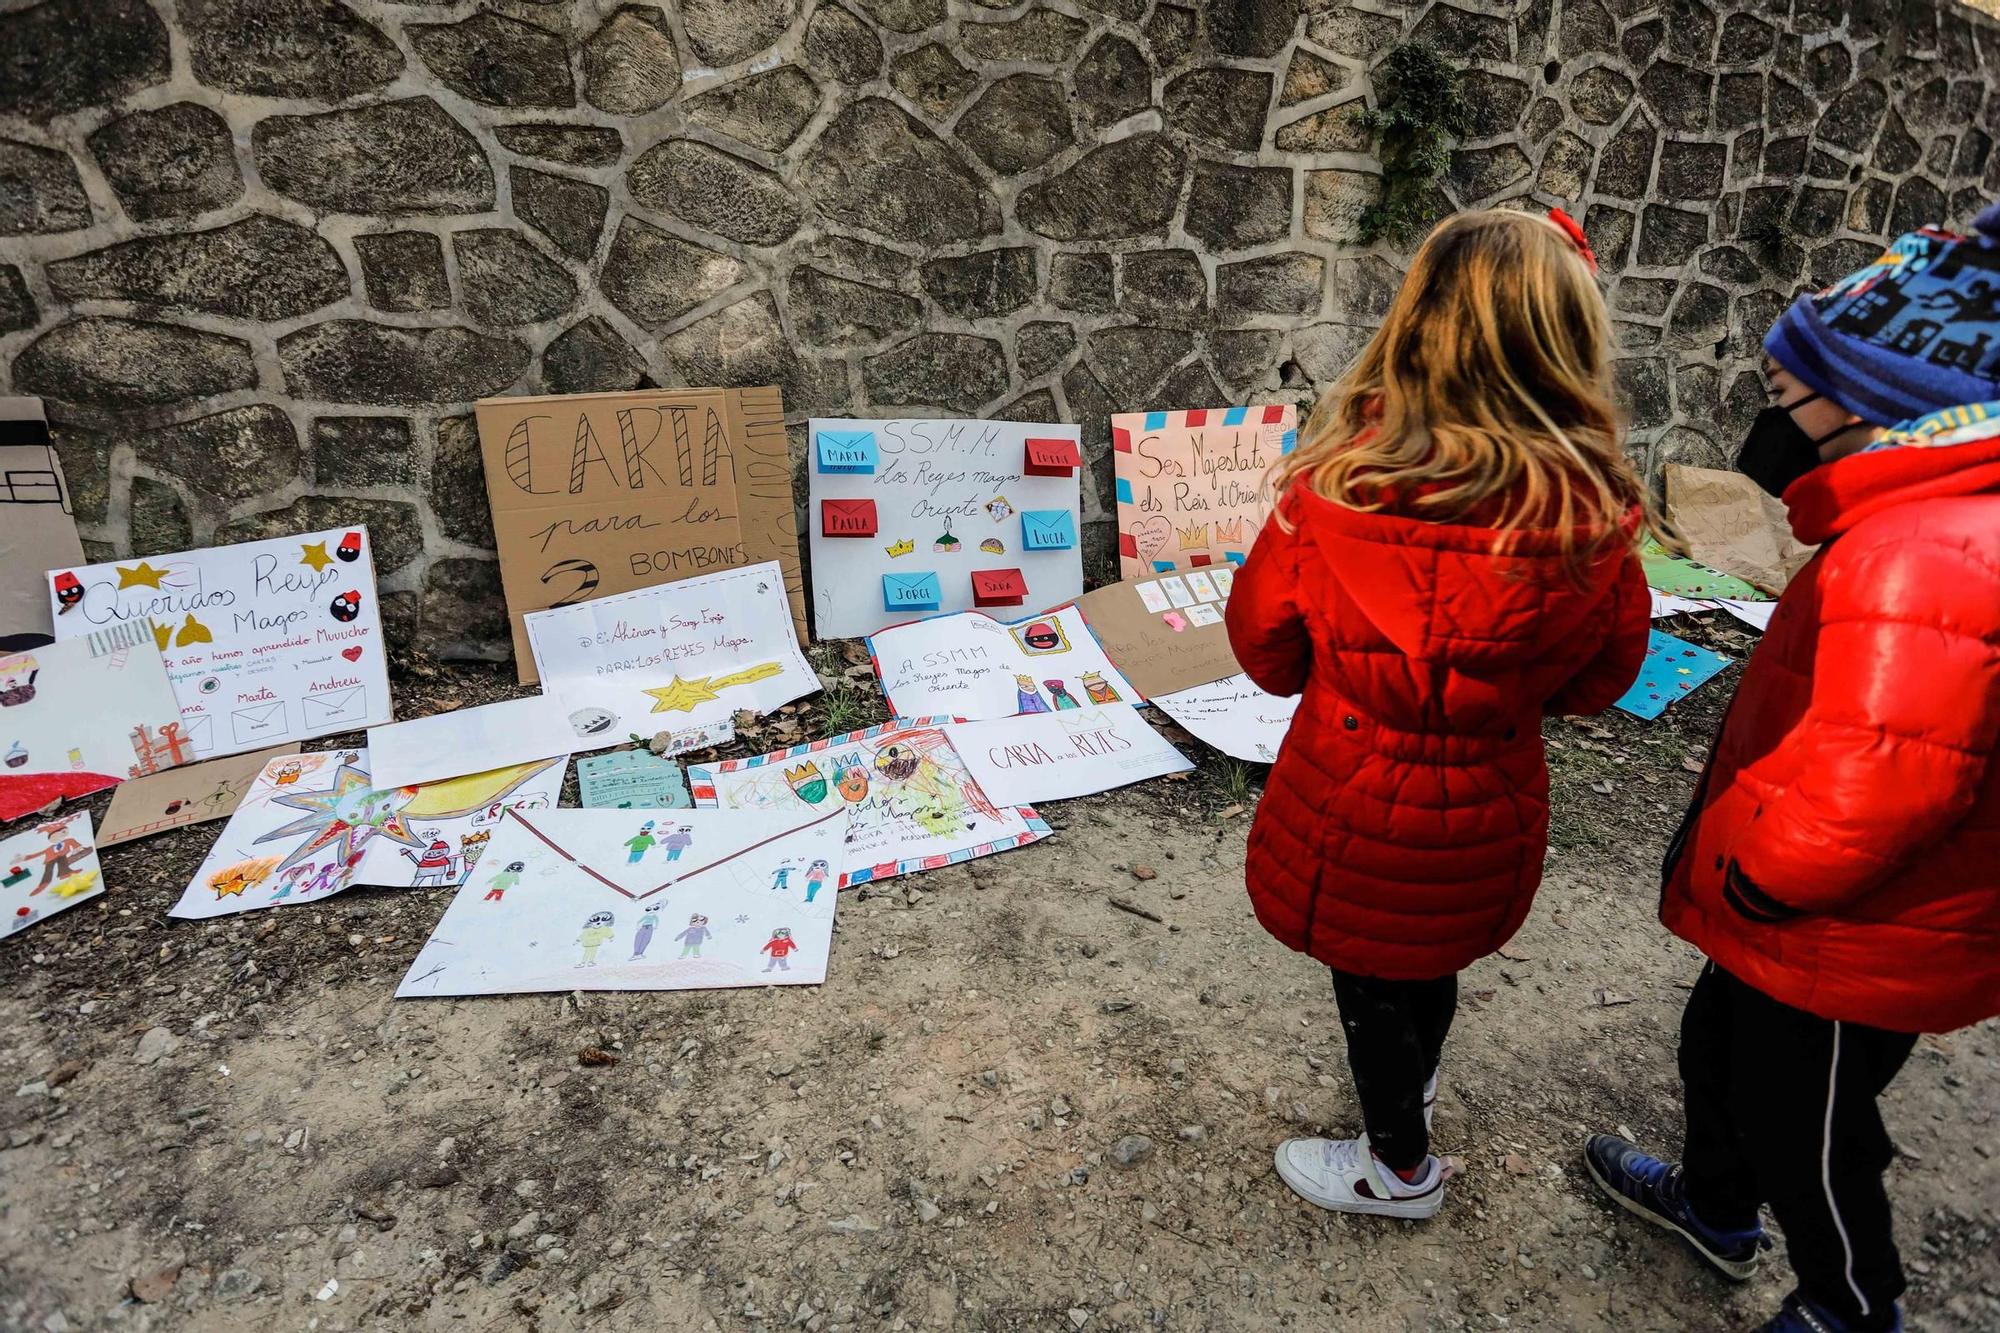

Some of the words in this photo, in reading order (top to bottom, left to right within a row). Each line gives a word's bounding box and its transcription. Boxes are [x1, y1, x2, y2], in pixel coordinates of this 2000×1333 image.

[505, 405, 736, 494] CARTA
[827, 449, 868, 462] MARTA
[1138, 436, 1187, 478] Ses
[1190, 431, 1266, 490] Majestats
[913, 460, 966, 496] Reyes
[911, 493, 978, 518] Oriente
[1139, 485, 1163, 513] els
[529, 514, 661, 553] para
[672, 497, 737, 523] los
[832, 514, 868, 530] PAULA
[1033, 528, 1066, 545] LUCIA
[83, 567, 236, 625] Queridos
[250, 553, 339, 602] Reyes
[252, 635, 312, 656] aprendido
[237, 686, 278, 704] Marta
[308, 674, 362, 693] Andreu
[989, 742, 1055, 769] CARTA
[1069, 728, 1132, 758] REYES
